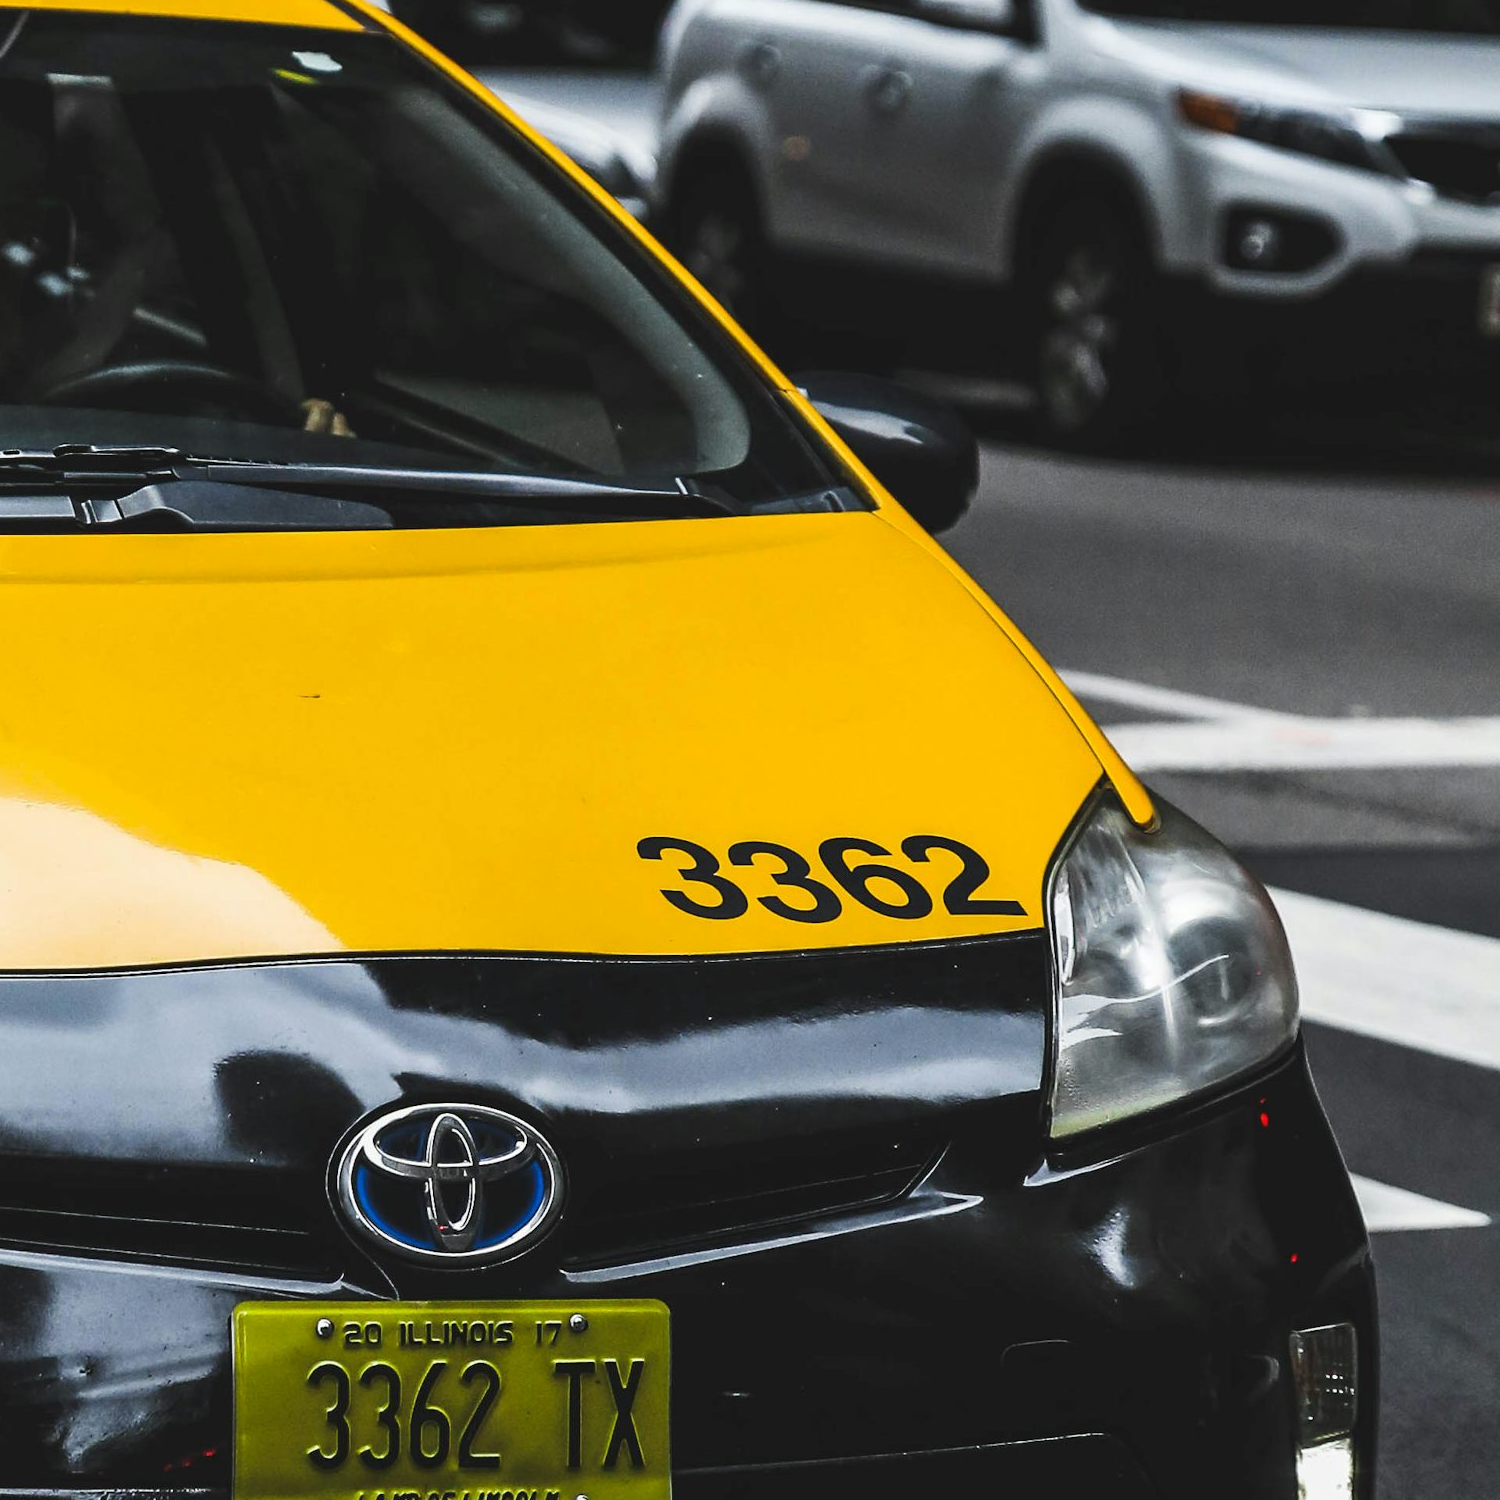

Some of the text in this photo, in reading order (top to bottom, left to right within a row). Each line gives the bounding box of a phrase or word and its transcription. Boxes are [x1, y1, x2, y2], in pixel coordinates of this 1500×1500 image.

[636, 835, 1028, 924] 3362
[343, 1320, 562, 1346] 20 ILLINOIS 17
[306, 1358, 646, 1470] 3362 TX
